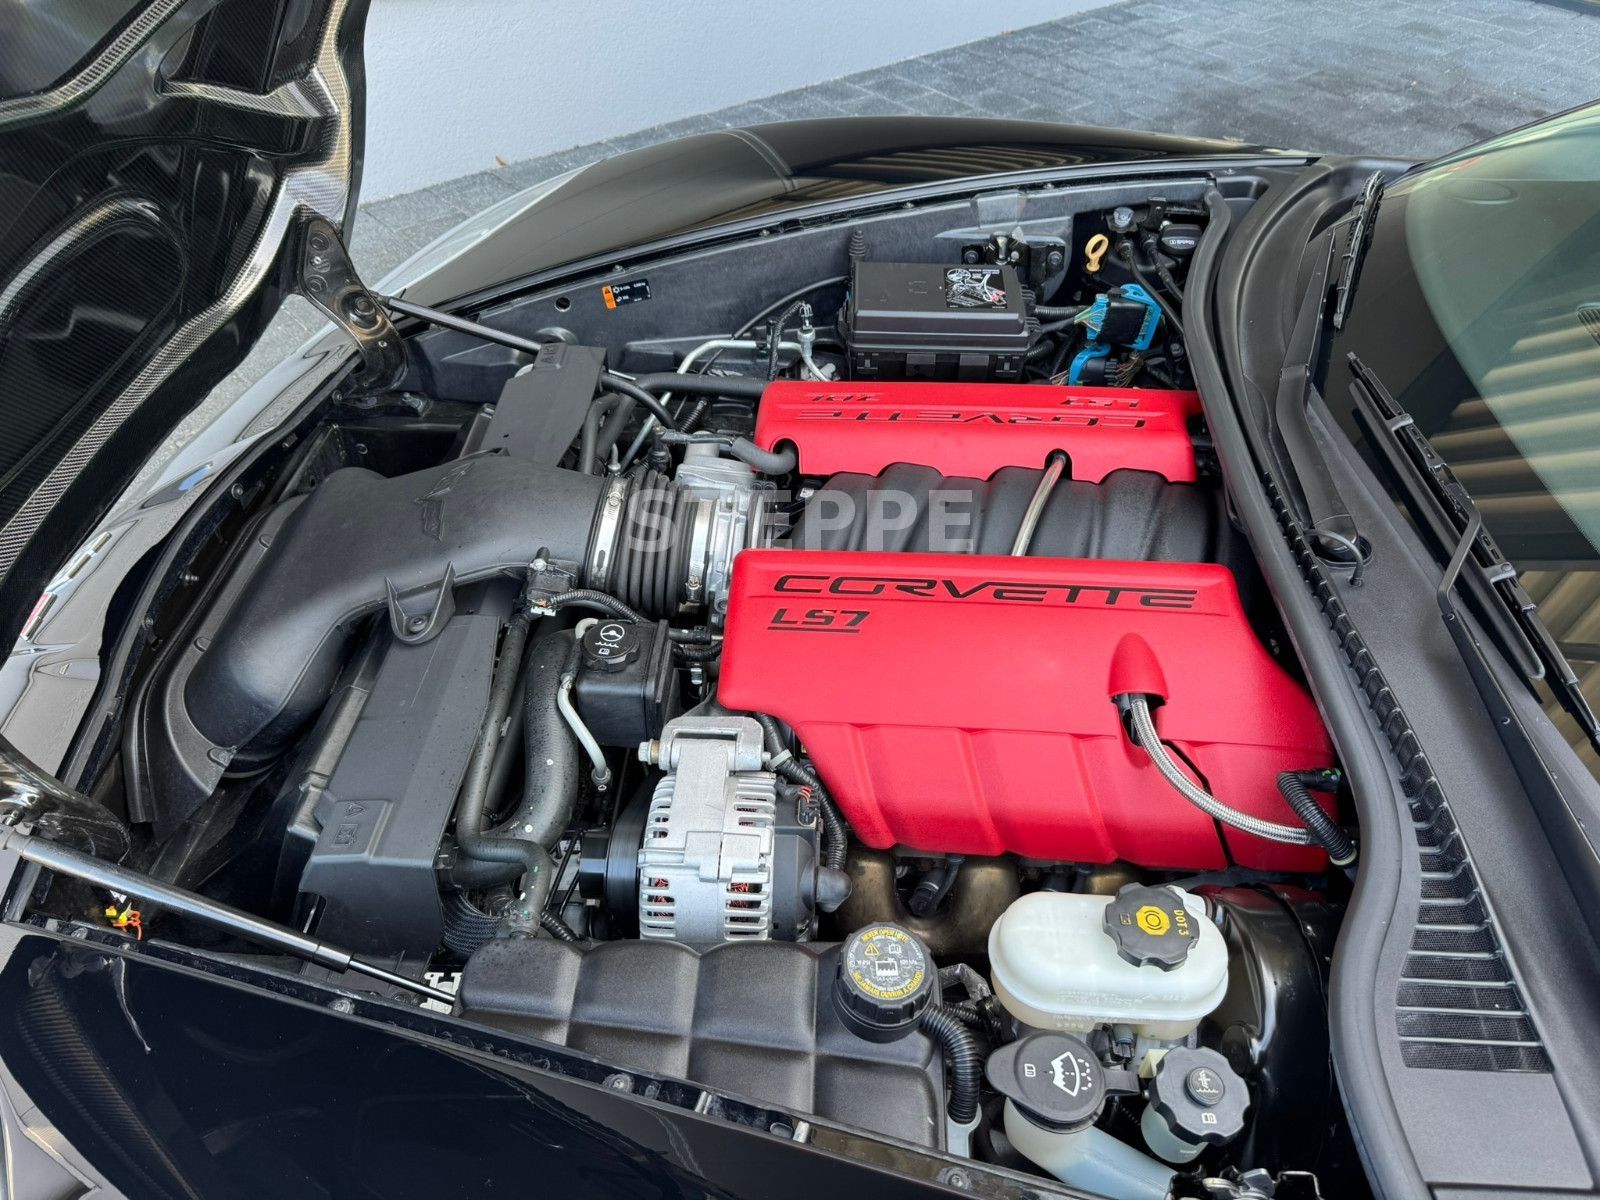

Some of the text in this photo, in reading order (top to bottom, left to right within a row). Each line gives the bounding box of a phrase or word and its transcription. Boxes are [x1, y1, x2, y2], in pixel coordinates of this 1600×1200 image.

[796, 409, 1147, 428] CORVETTE
[774, 575, 1198, 609] CORVETTE
[769, 608, 871, 629] LS7
[1174, 909, 1189, 929] DOT
